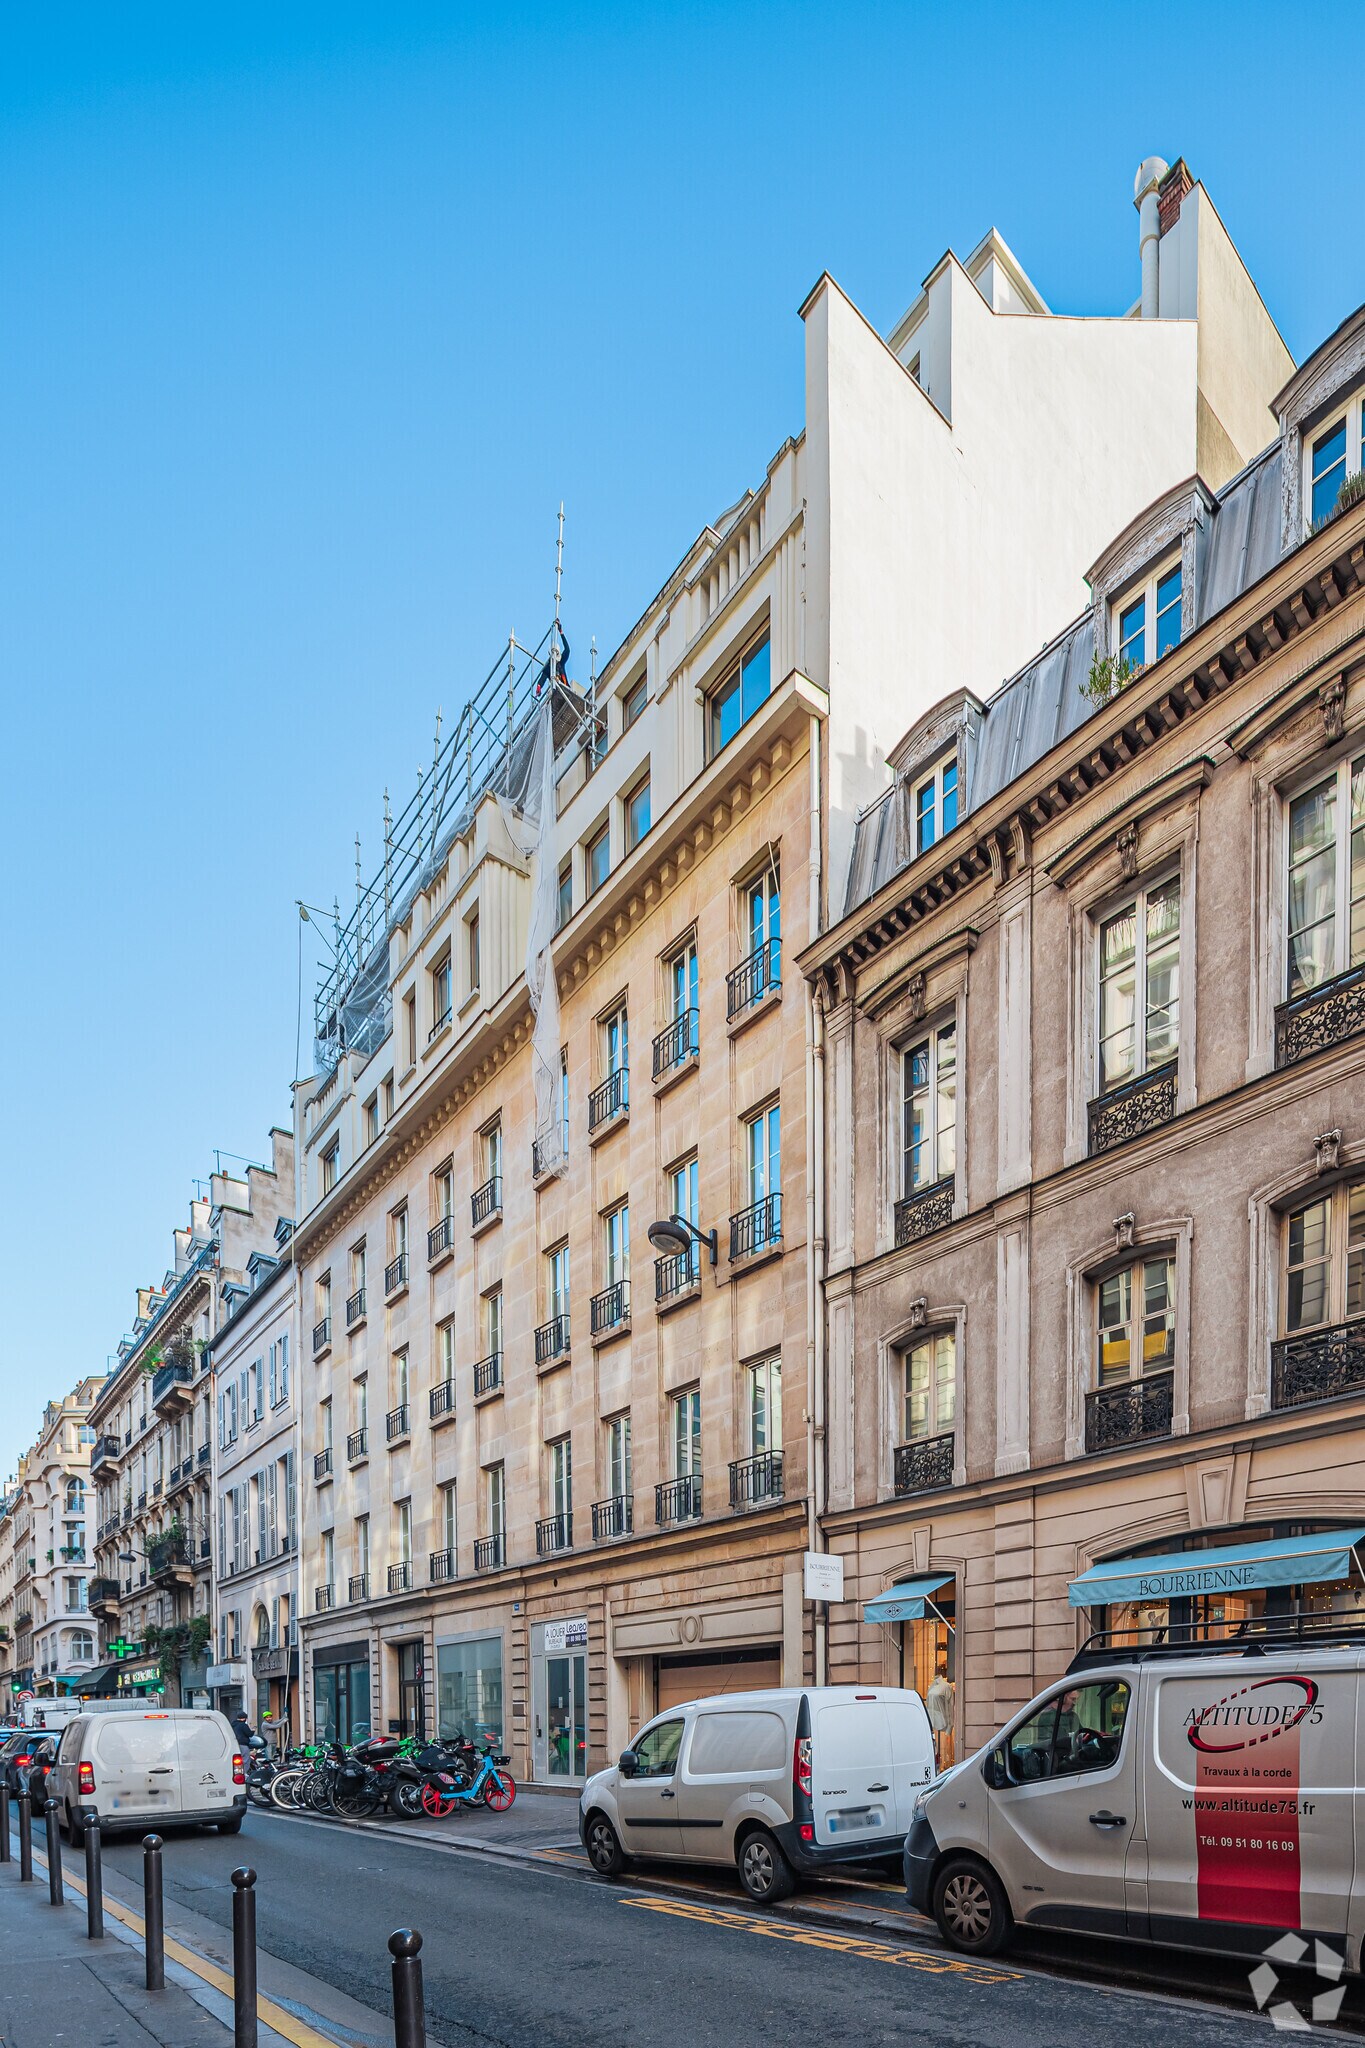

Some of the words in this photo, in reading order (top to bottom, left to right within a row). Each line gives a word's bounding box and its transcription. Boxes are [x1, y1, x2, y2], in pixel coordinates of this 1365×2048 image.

[1139, 1567, 1256, 1596] BOURRIENNE
[1183, 1704, 1325, 1727] ALTITUDE75
[1202, 1766, 1240, 1777] Travaux
[1243, 1767, 1249, 1777] à
[1251, 1767, 1261, 1777] la
[1263, 1768, 1292, 1778] corde
[910, 1780, 931, 1788] RENAULT
[1182, 1798, 1316, 1816] www.altitude75.fr
[1200, 1836, 1218, 1847] Tél.
[1220, 1837, 1233, 1848] 09
[1235, 1838, 1247, 1849] 51
[1250, 1839, 1263, 1850] 80
[1266, 1840, 1279, 1851] 16
[1281, 1841, 1294, 1852] 09
